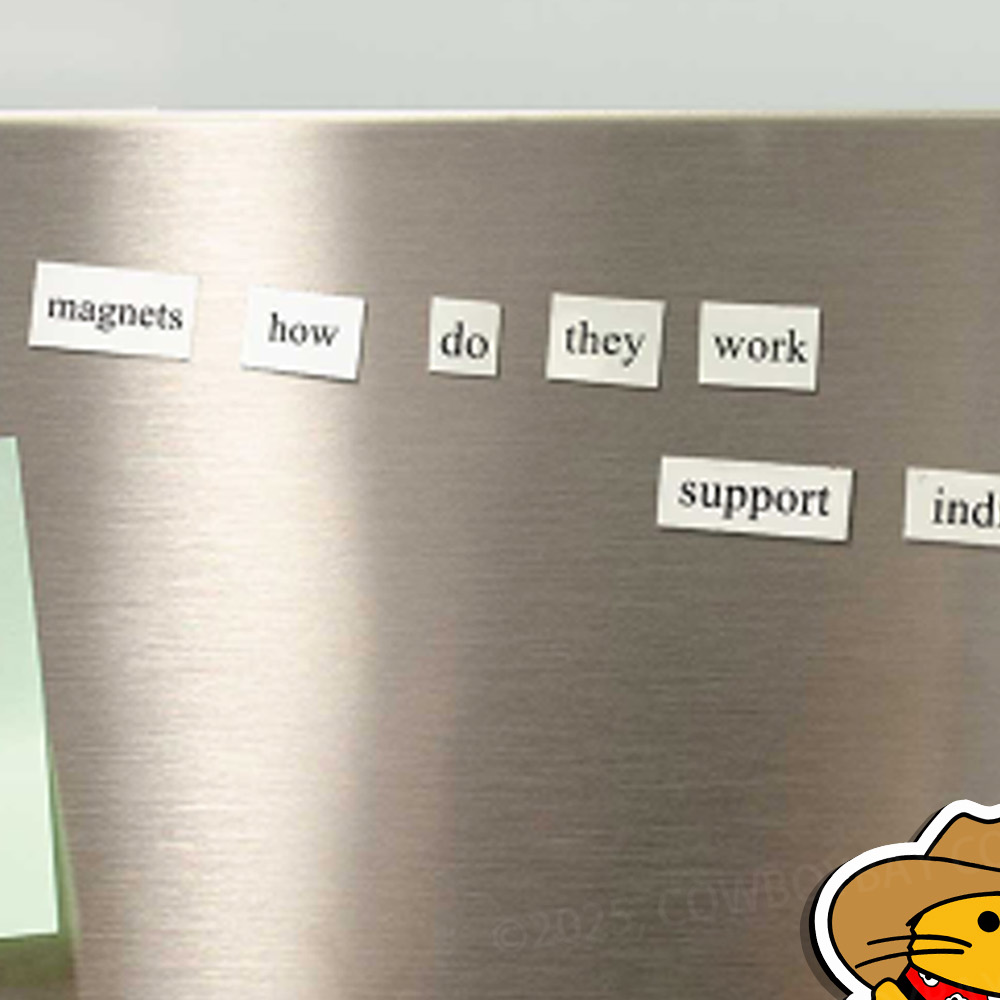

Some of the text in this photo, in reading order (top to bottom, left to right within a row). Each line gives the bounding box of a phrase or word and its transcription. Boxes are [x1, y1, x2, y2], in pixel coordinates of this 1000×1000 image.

[47, 295, 809, 367] magnets how do they work
[677, 477, 831, 520] support
